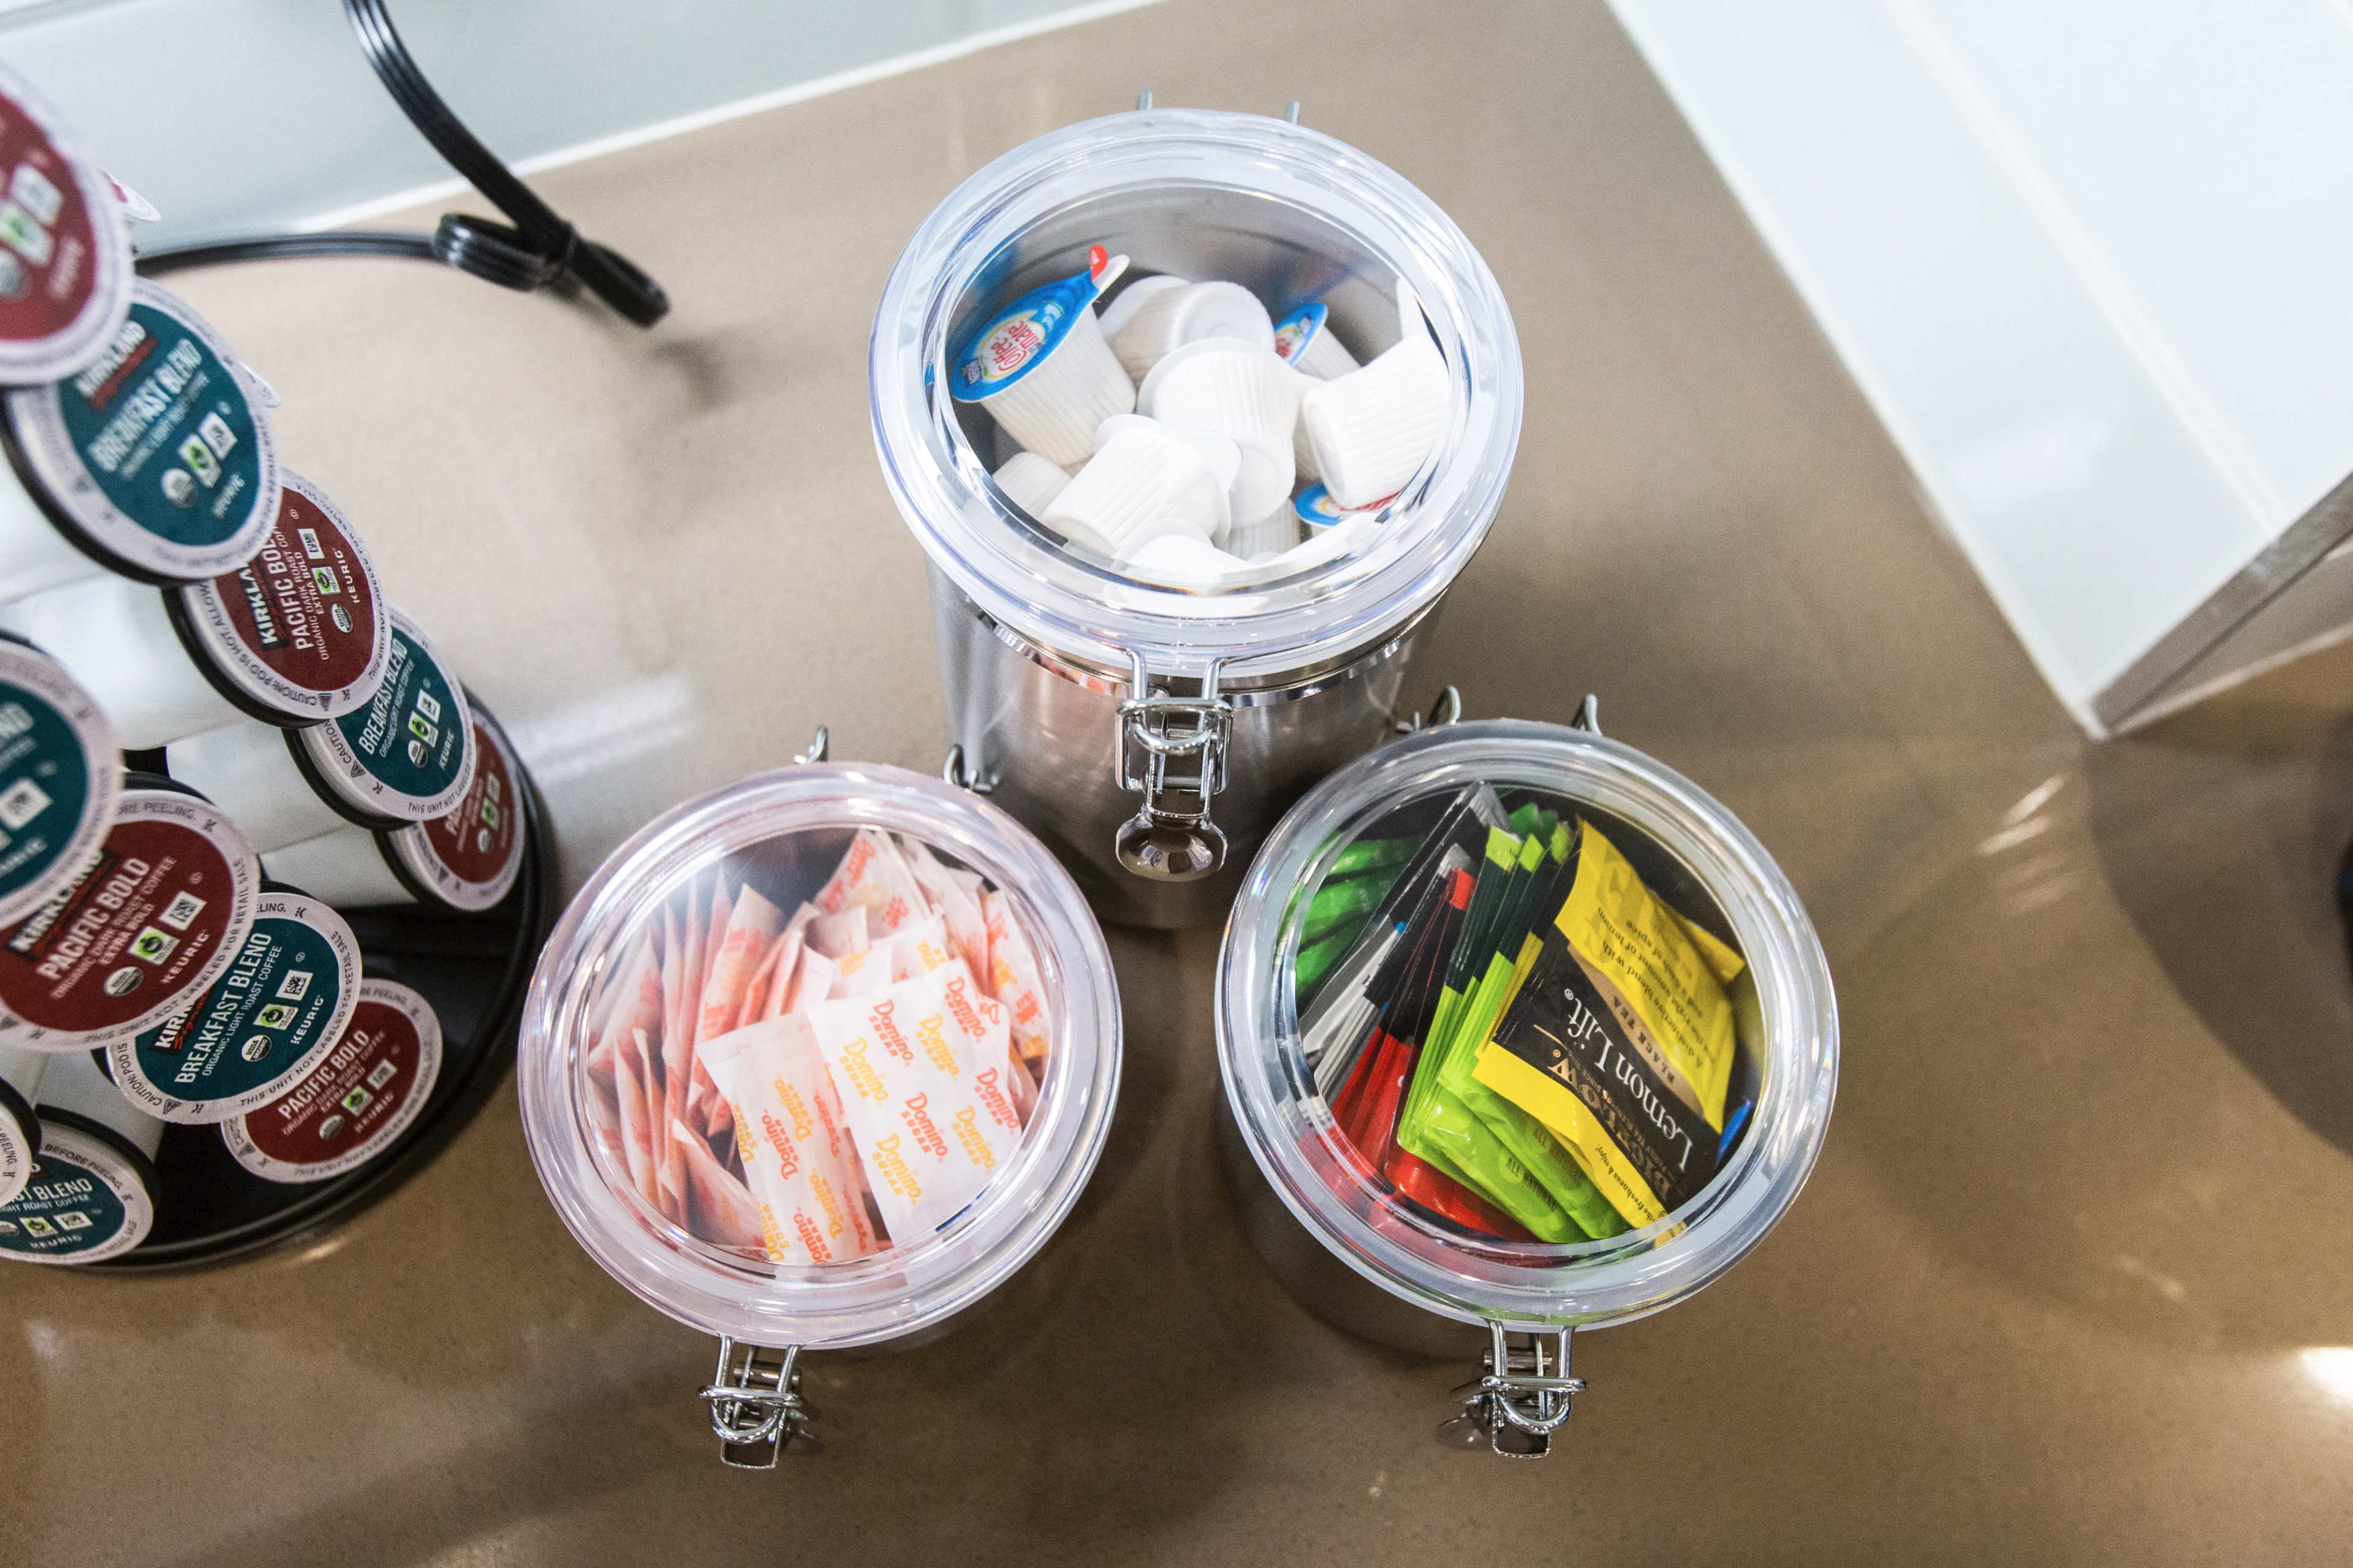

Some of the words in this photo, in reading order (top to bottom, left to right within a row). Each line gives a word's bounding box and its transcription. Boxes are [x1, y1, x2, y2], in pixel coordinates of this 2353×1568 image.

[284, 551, 303, 583] ROAST
[294, 551, 312, 579] BOLD
[334, 549, 360, 604] KEURIG
[275, 578, 314, 650] PACIFIC
[300, 586, 314, 613] DARK
[307, 581, 325, 615] EXTRA
[308, 615, 330, 661] ORGANIC
[358, 678, 395, 756] BREAKFAST
[390, 638, 407, 681] BLEND
[439, 728, 455, 769] KEURIG
[408, 802, 425, 814] THIS
[426, 801, 444, 814] UNIT
[36, 907, 110, 980] PACIFIC
[94, 857, 151, 910] BOLD
[1595, 907, 1627, 945] lemon
[1624, 919, 1653, 949] spice
[160, 931, 210, 983] KEURIG
[330, 931, 347, 952] SALE
[1599, 941, 1626, 969] with
[1623, 941, 1638, 956] of
[343, 952, 354, 985] RETAIL
[1624, 964, 1655, 999] blend
[175, 990, 243, 1083] BREAKFAST
[228, 933, 272, 988] BLEND
[202, 1036, 230, 1076] ORGANIC
[223, 1010, 244, 1037] LIGHT
[241, 982, 264, 1011] ROAST
[258, 945, 282, 980] COFFEE
[342, 987, 353, 1008] FOR
[947, 975, 987, 1038] Domino
[1612, 995, 1637, 1029] TEA
[290, 997, 324, 1045] KEURIG
[317, 1011, 346, 1055] LABELED
[869, 1016, 898, 1058] SUGAR
[873, 999, 914, 1062] Domino
[1566, 998, 1613, 1070] Lift
[118, 1043, 127, 1053] IS
[118, 1054, 134, 1075] POD
[246, 1040, 259, 1056] USDA
[295, 1056, 315, 1075] NOT
[919, 1012, 960, 1080] Domino
[1637, 1031, 1675, 1083] BLACK
[269, 1075, 294, 1094] UNIT
[278, 1066, 336, 1120] PACIFIC
[330, 1029, 369, 1071] BOLD
[842, 1037, 889, 1102] Domino
[240, 1093, 265, 1106] THIS
[775, 1077, 813, 1142] Domino
[977, 1067, 1020, 1131] Domino
[1613, 1051, 1694, 1172] Lemon
[901, 1111, 931, 1154] SUGAR
[904, 1092, 949, 1158] Domino
[954, 1105, 998, 1171] Domino
[1547, 1057, 1675, 1200] BIGELOW
[45, 1143, 89, 1163] BEFORE
[762, 1113, 799, 1180] Domino
[875, 1133, 923, 1200] Domino
[1505, 1156, 1523, 1178] ALL
[32, 1178, 93, 1201] BLEND
[1605, 1165, 1615, 1175] &
[809, 1174, 844, 1240] Domino
[1611, 1172, 1645, 1211] freshness
